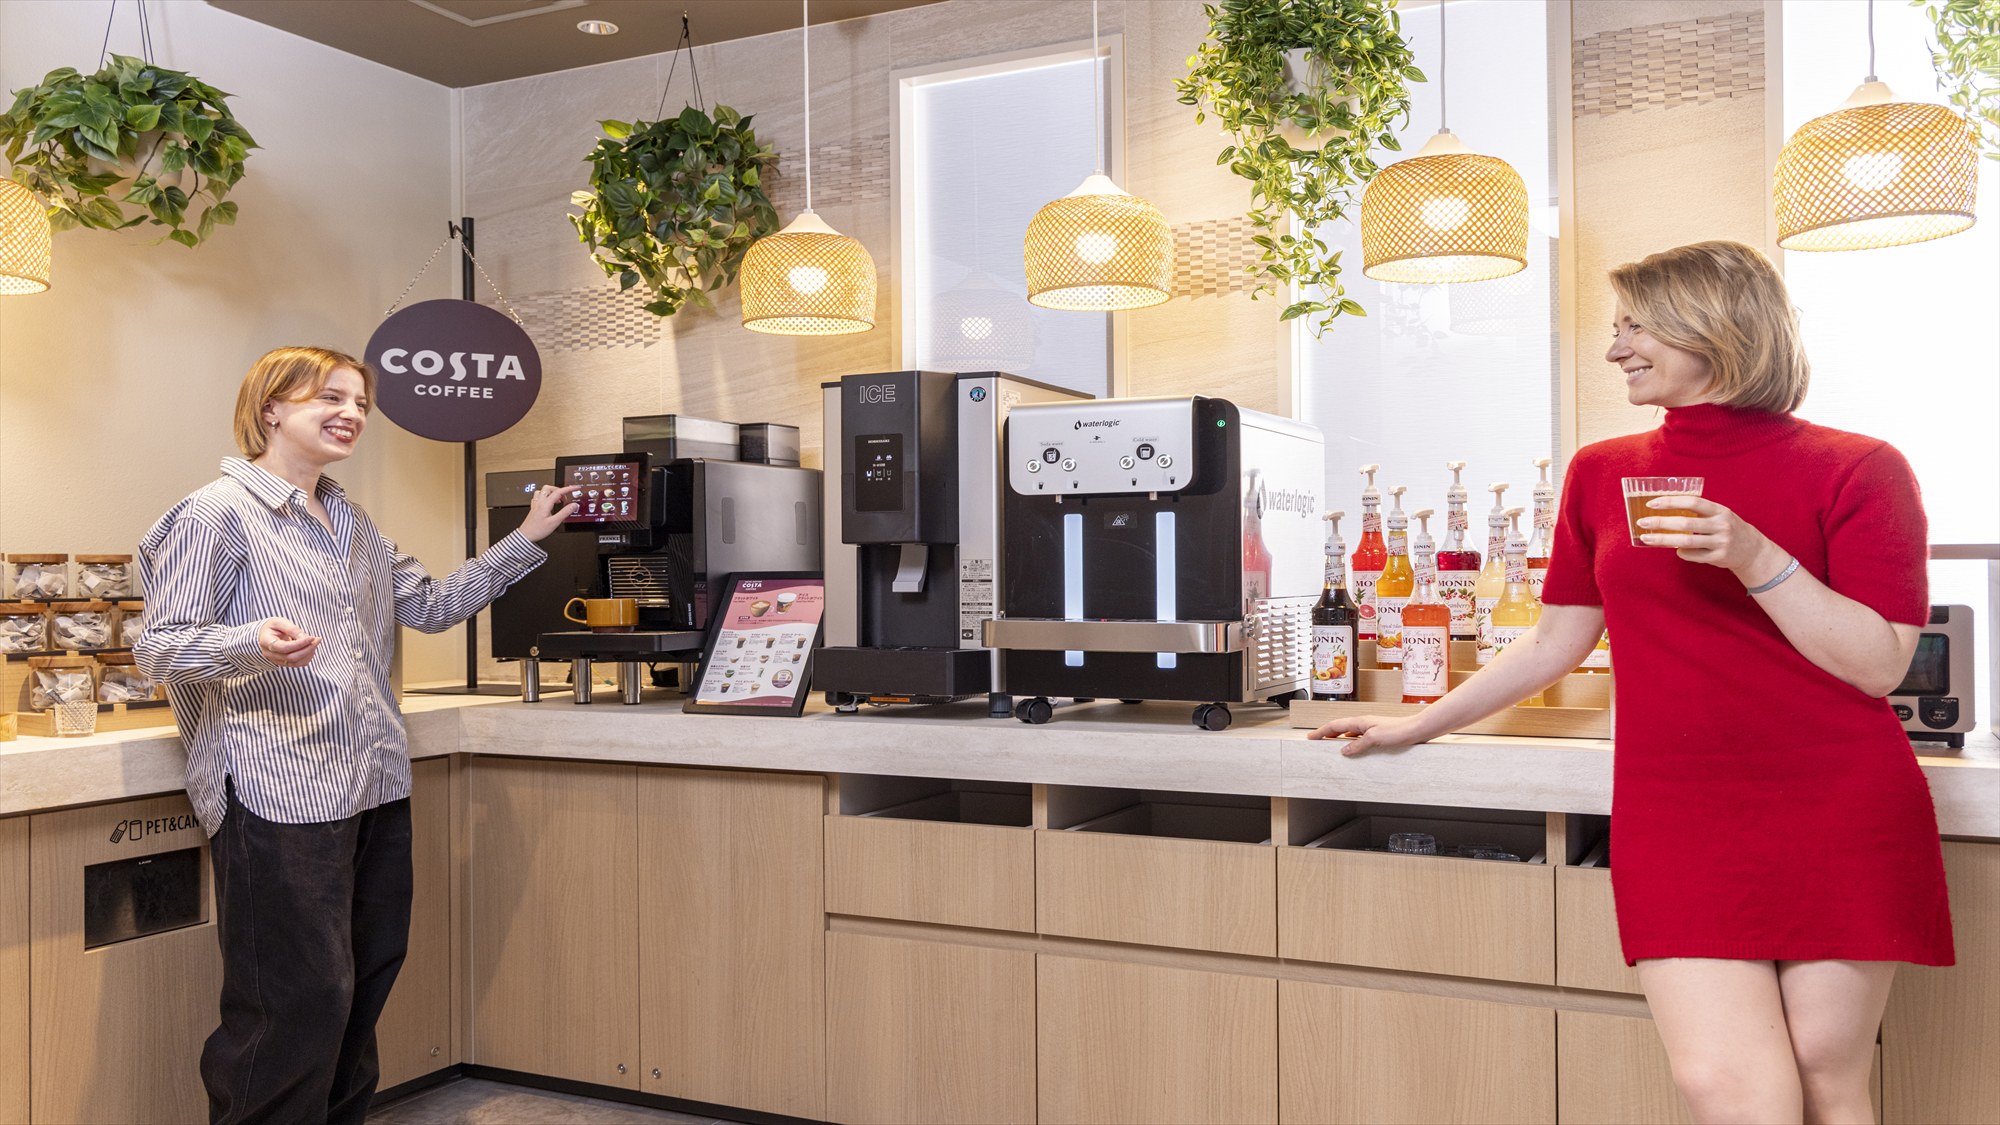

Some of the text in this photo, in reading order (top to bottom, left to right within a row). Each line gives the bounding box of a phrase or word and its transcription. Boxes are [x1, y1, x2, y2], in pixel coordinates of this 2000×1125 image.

[380, 348, 526, 381] COSTA
[414, 384, 494, 399] COFFEE
[859, 384, 896, 404] ICE
[1082, 419, 1120, 428] waterlogic
[1268, 490, 1315, 519] waterlogic
[146, 815, 199, 835] PET&CAN
